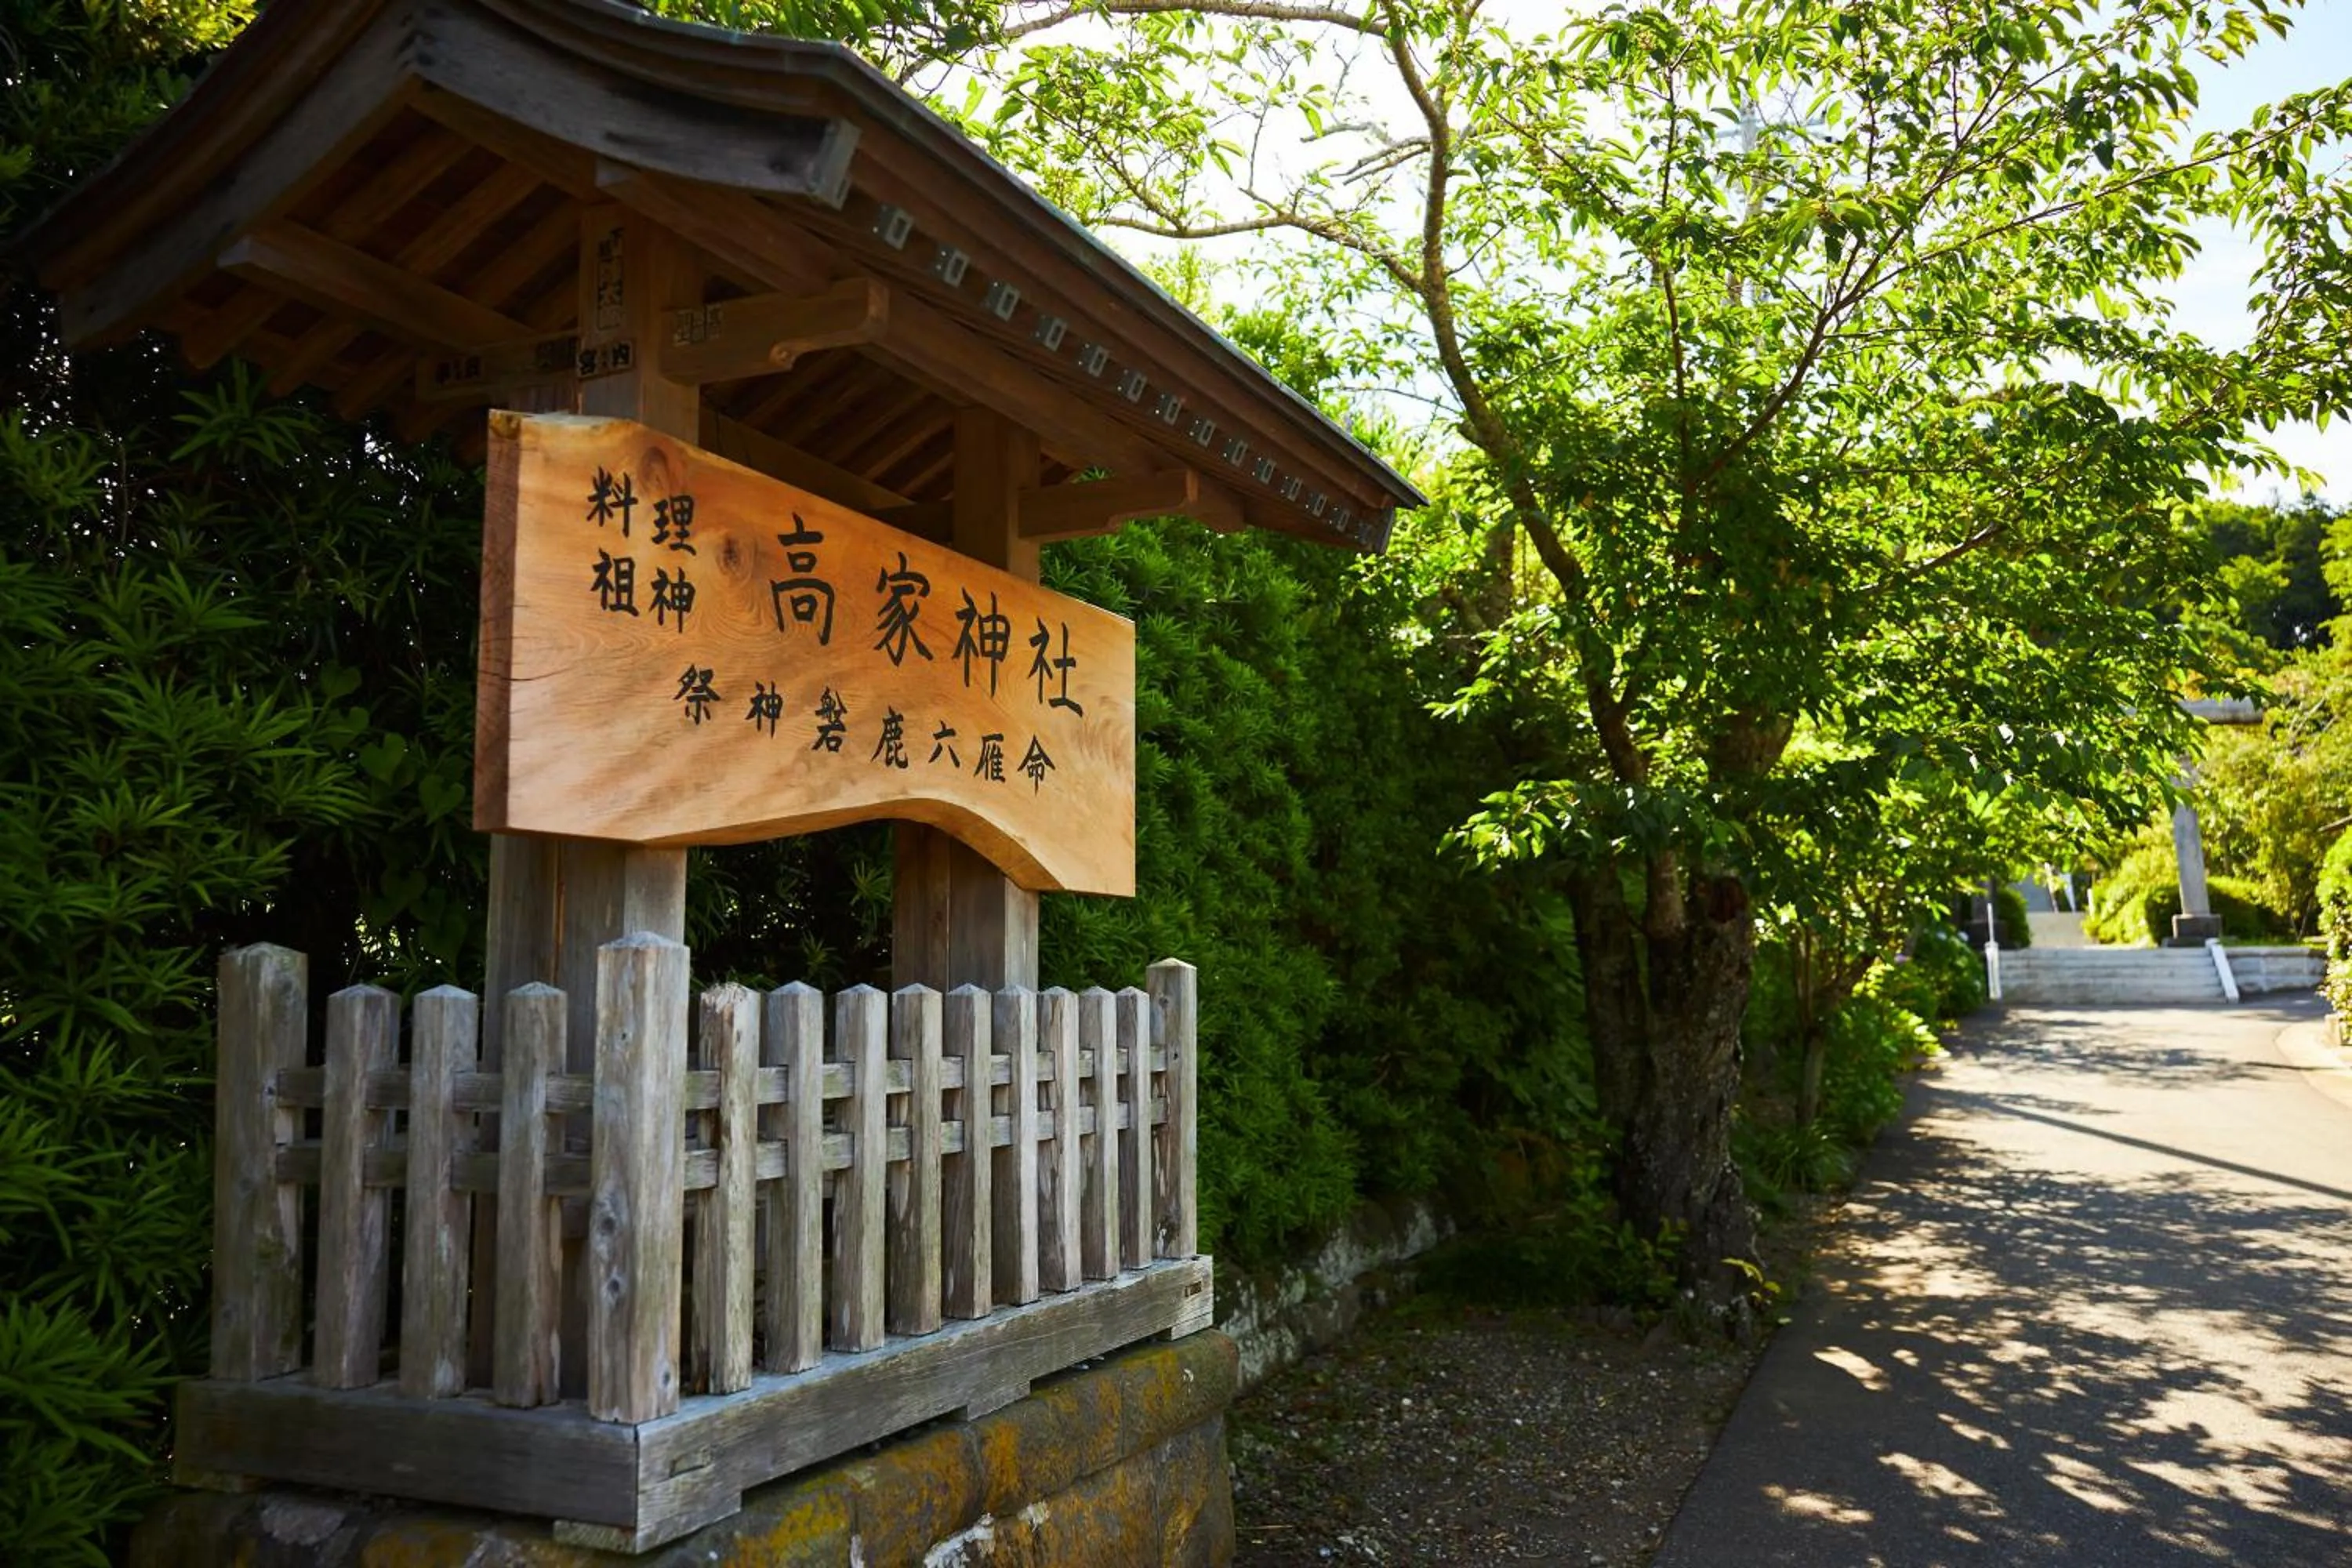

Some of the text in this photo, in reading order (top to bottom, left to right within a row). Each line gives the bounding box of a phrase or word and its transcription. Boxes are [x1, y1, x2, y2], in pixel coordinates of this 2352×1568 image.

[586, 466, 697, 556] 料理
[590, 548, 695, 633] 祖神
[770, 513, 1084, 718] 高家神社
